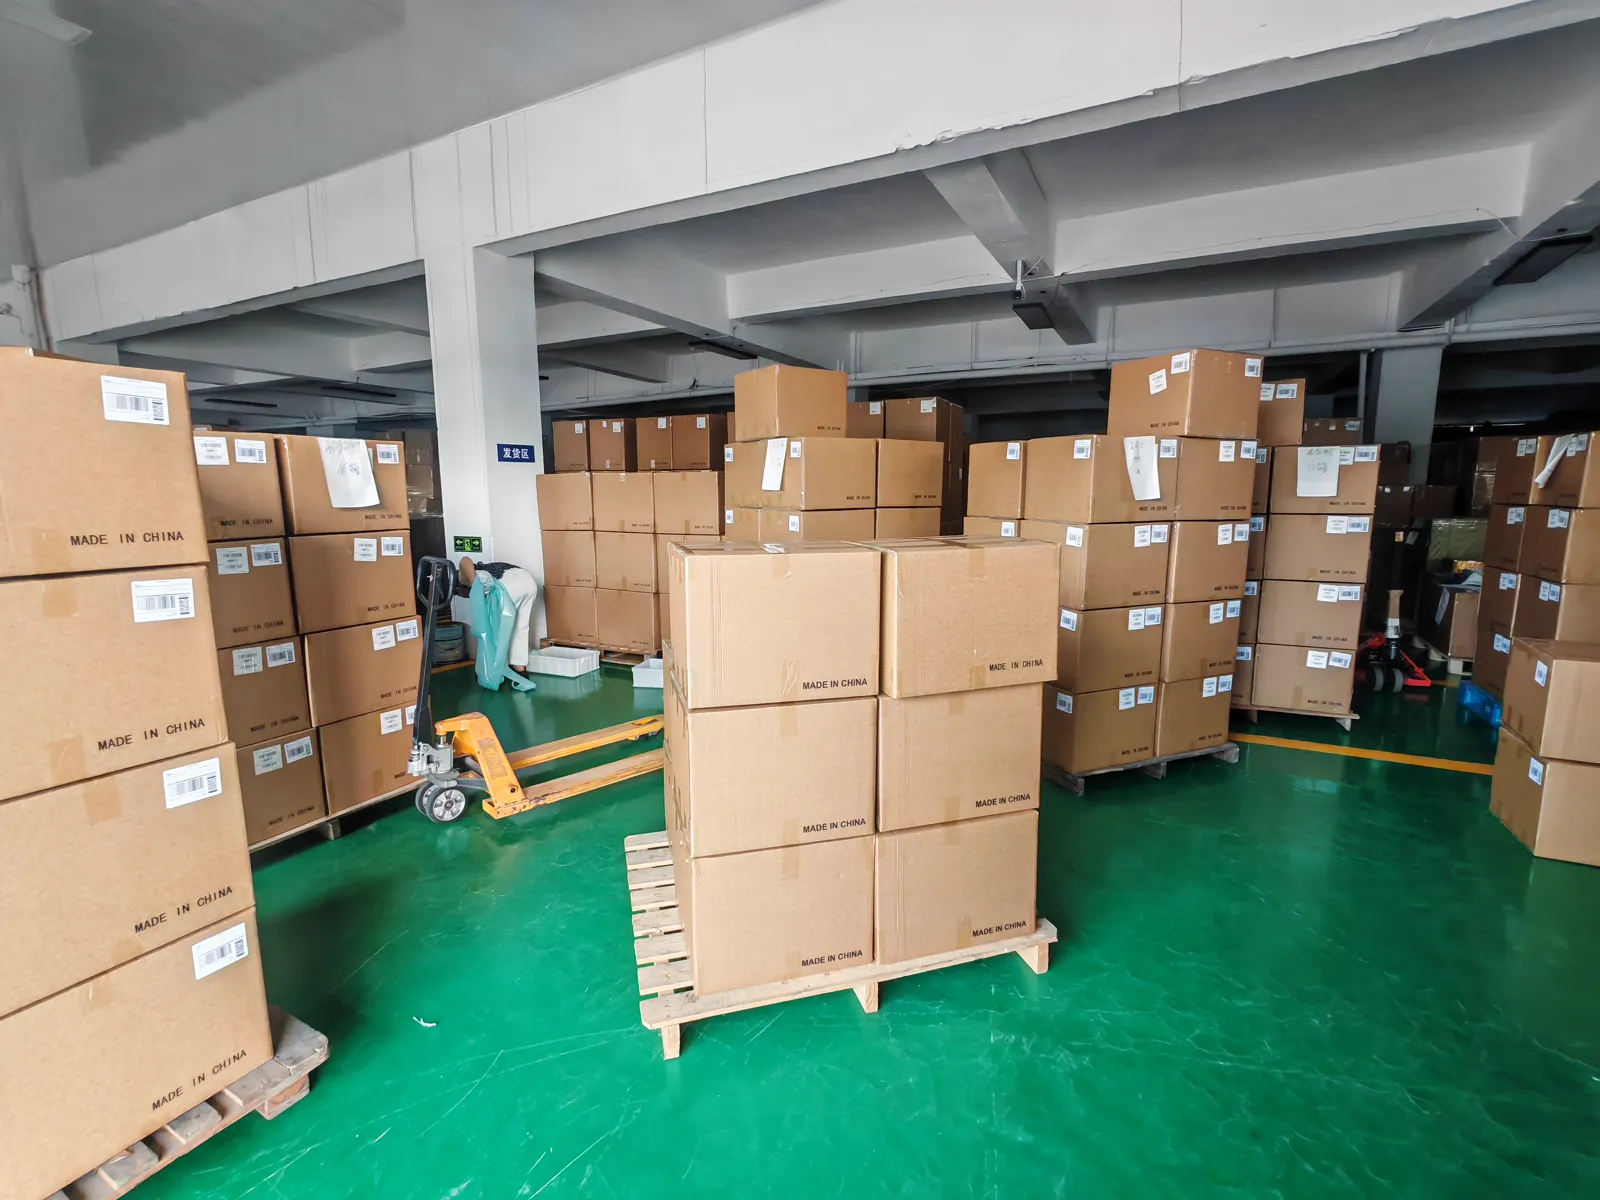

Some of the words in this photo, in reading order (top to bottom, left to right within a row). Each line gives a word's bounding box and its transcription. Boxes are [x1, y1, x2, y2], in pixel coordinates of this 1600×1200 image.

[503, 447, 530, 459] 发货区
[70, 534, 108, 546] MADE
[119, 533, 134, 543] IN
[143, 531, 184, 543] CHINA
[989, 662, 1006, 671] MADE
[1011, 661, 1019, 669] IN
[1022, 659, 1043, 667] CHINA
[802, 681, 828, 690] MADE
[830, 680, 839, 688] IN
[841, 678, 868, 688] CHINA
[97, 735, 133, 751] MADE
[144, 729, 158, 740] IN
[166, 718, 205, 735] CHINA
[975, 799, 997, 808] MADE
[998, 797, 1006, 805] IN
[1008, 793, 1031, 803] CHINA
[803, 824, 828, 834] MADE
[829, 821, 838, 829] IN
[840, 818, 866, 827] CHINA
[134, 913, 167, 933] MADE
[176, 903, 190, 915] IN
[197, 886, 233, 907] CHINA
[972, 927, 993, 937] MADE
[1004, 920, 1027, 930] CHINA
[801, 957, 826, 967] MADE
[837, 950, 863, 960] CHINA
[152, 1086, 183, 1111] MADE
[192, 1073, 205, 1086] IN
[212, 1049, 246, 1074] CHINA
